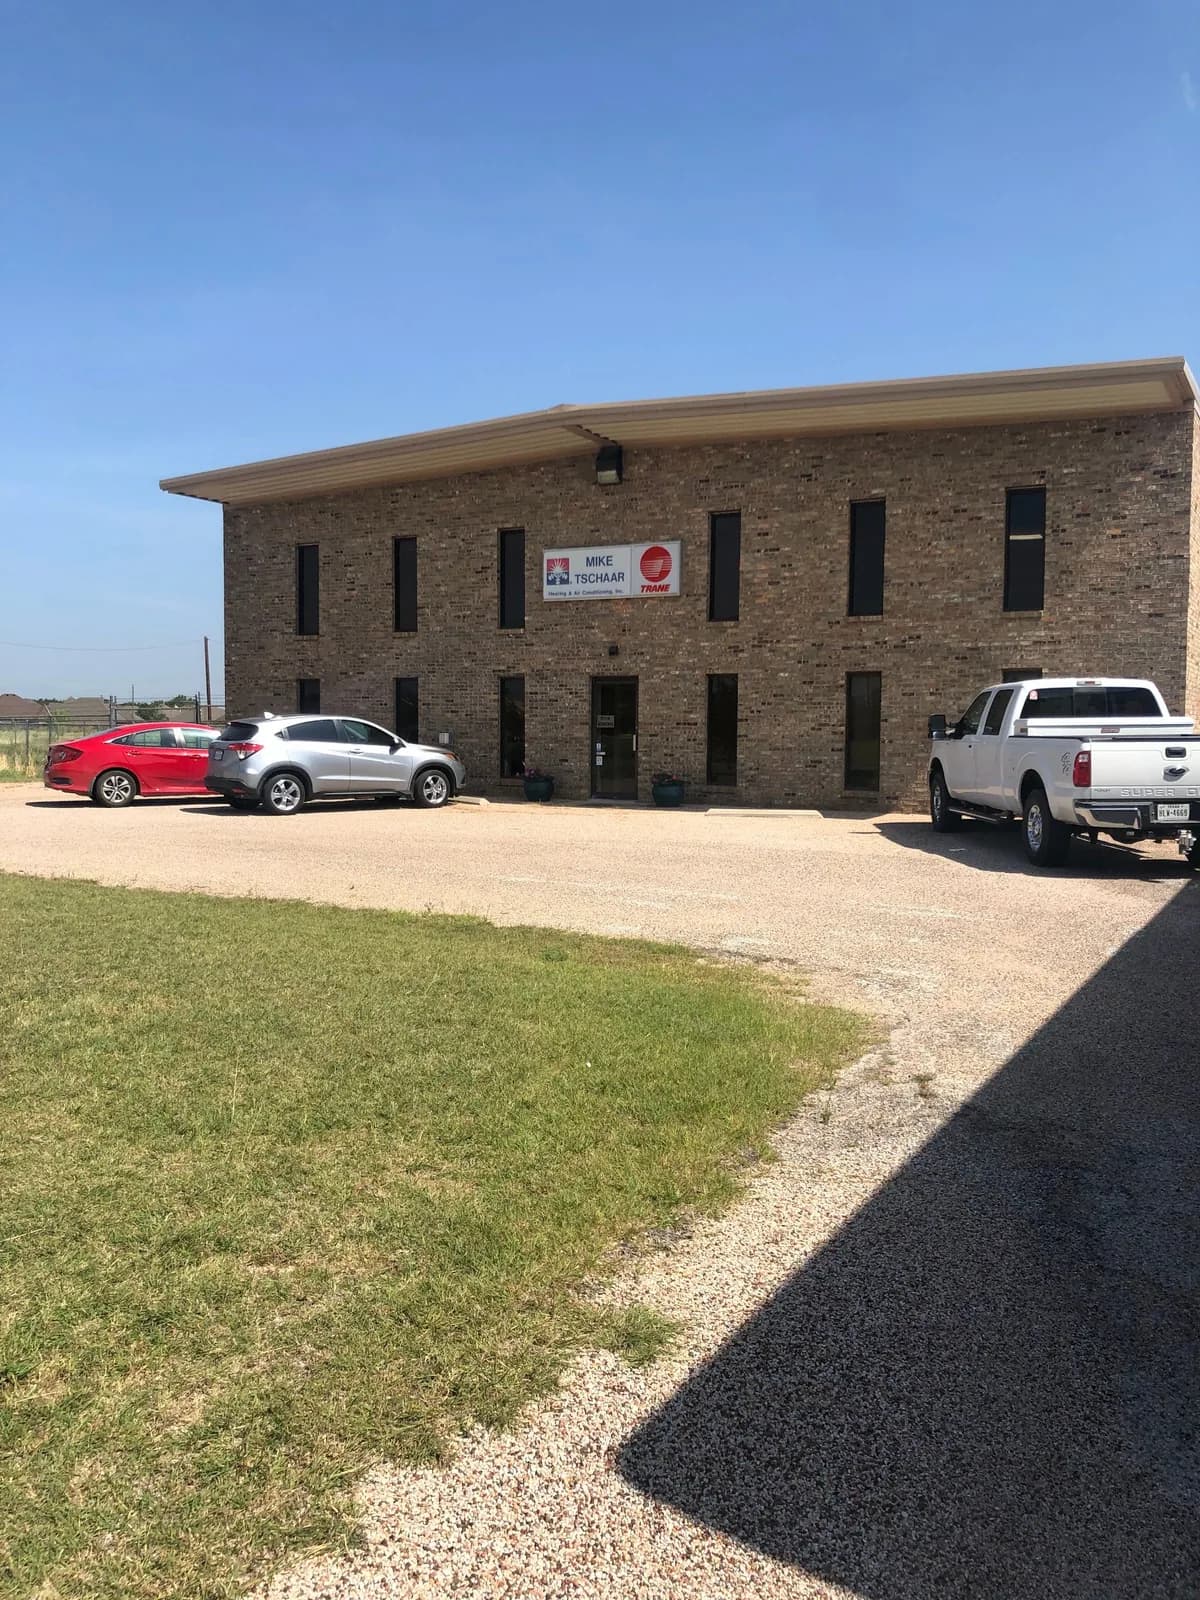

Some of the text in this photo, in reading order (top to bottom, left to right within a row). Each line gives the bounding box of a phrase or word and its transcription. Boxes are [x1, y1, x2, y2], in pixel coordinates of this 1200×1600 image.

[586, 556, 613, 567] MIKE
[575, 572, 625, 584] TSCHAAR
[641, 584, 670, 593] TRANE
[1120, 788, 1176, 797] SUPER
